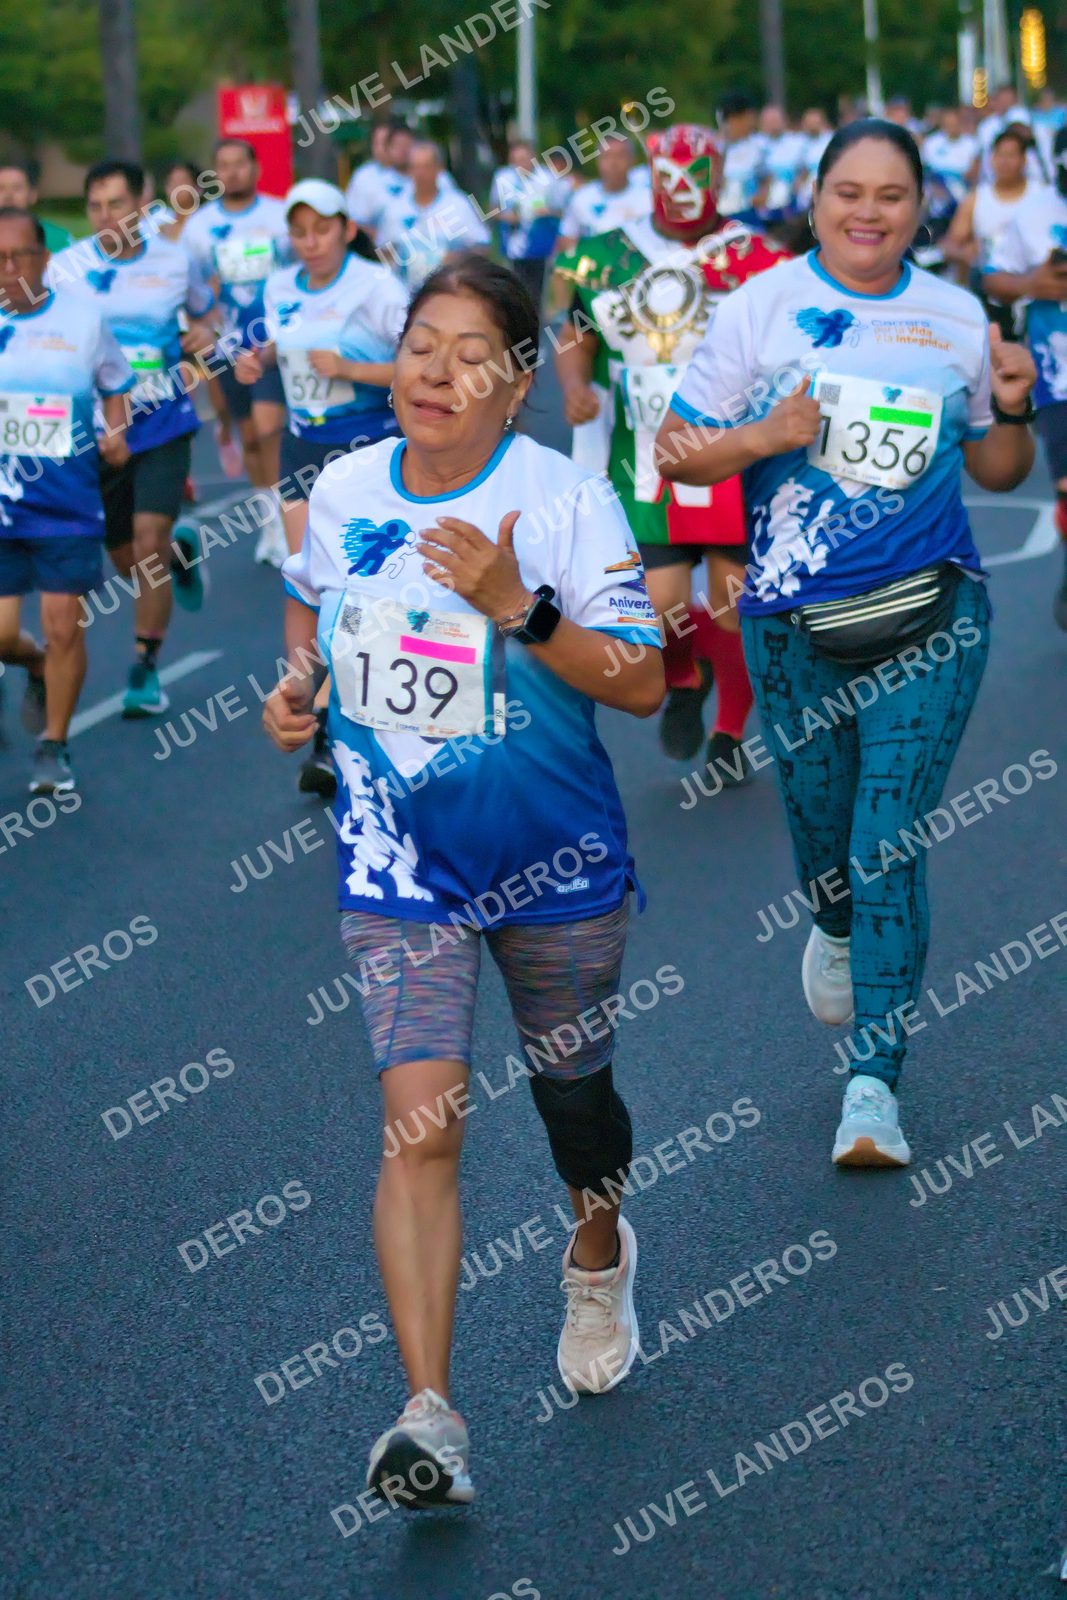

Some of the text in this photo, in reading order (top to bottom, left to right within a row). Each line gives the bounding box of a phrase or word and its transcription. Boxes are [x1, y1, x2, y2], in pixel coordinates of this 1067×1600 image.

[896, 335, 952, 351] Integridad
[908, 327, 933, 337] Vida
[635, 394, 664, 423] 19
[3, 418, 60, 448] 807
[820, 415, 928, 477] 1356
[356, 651, 458, 720] 139
